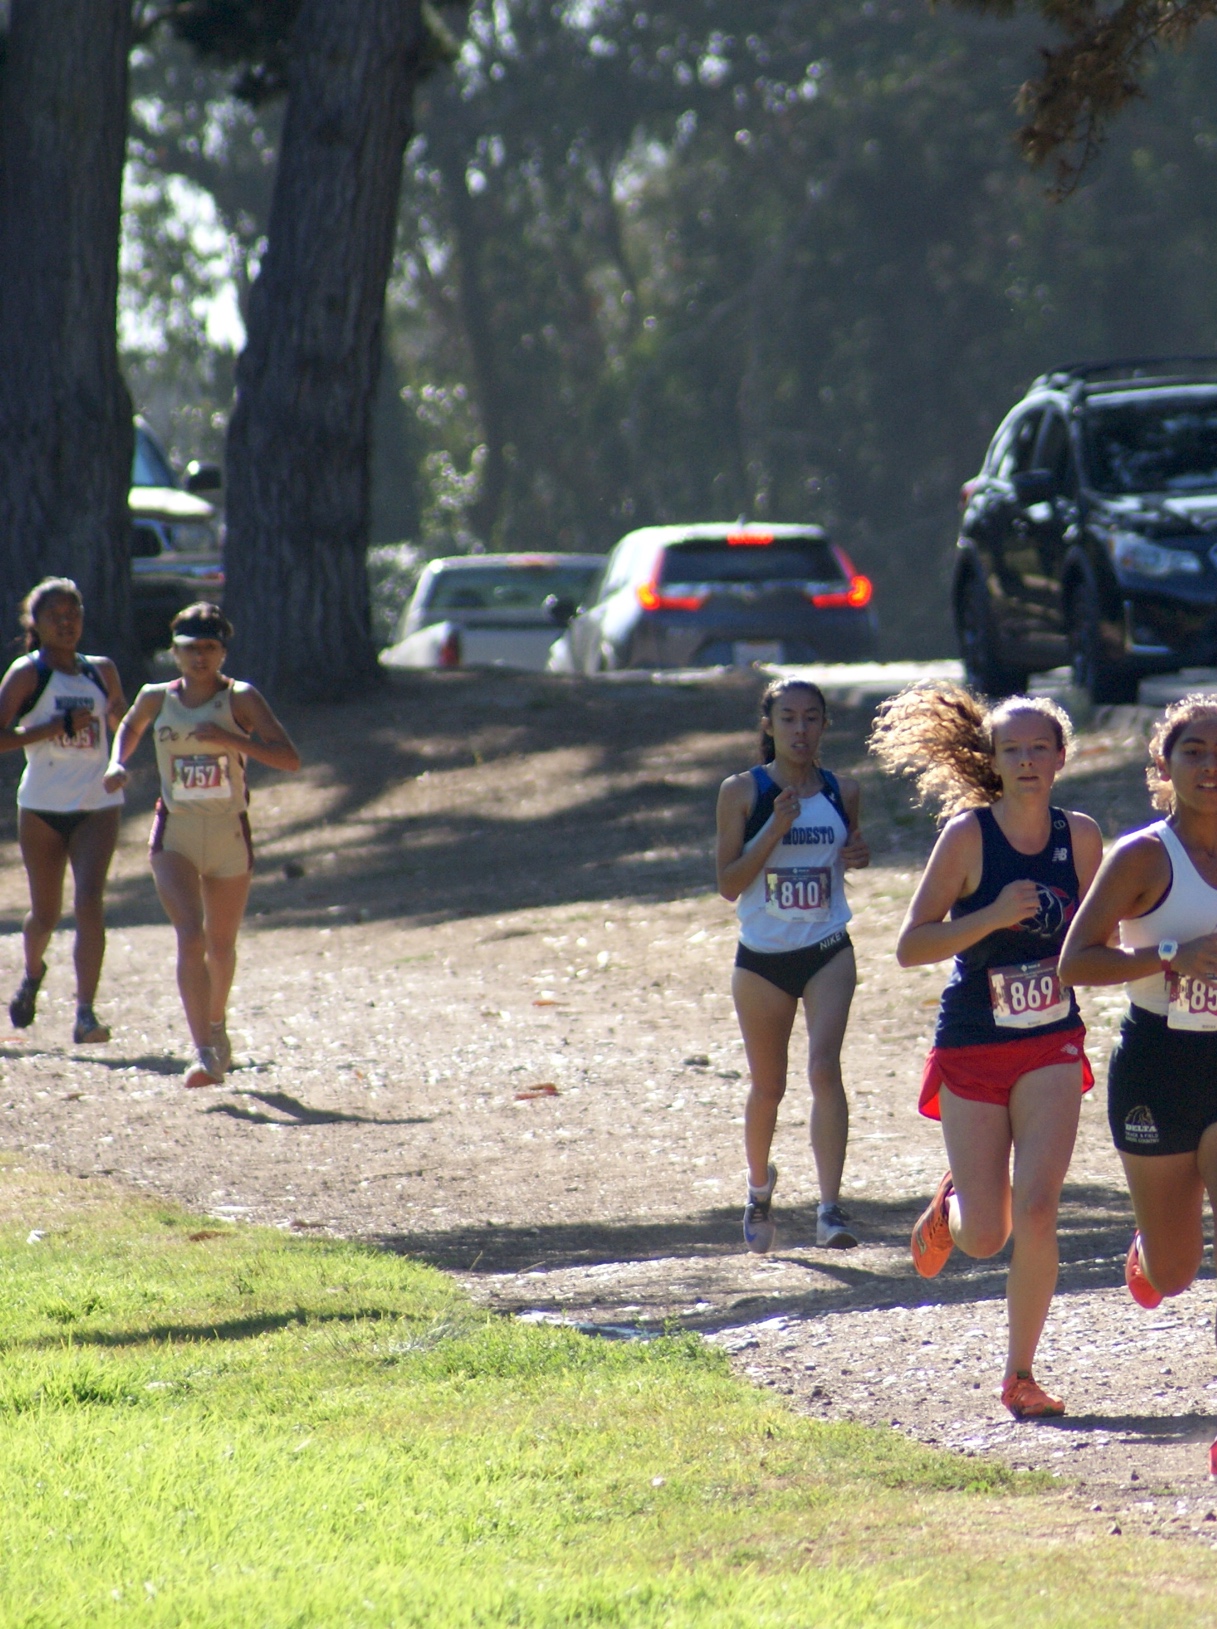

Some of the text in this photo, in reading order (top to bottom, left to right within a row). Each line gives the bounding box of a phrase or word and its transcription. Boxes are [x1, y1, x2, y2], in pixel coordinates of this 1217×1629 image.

[184, 766, 216, 787] 757
[781, 881, 819, 907] 810
[820, 931, 842, 951] NIKE
[1010, 976, 1053, 1012] 869
[1125, 1123, 1157, 1132] DELTA
